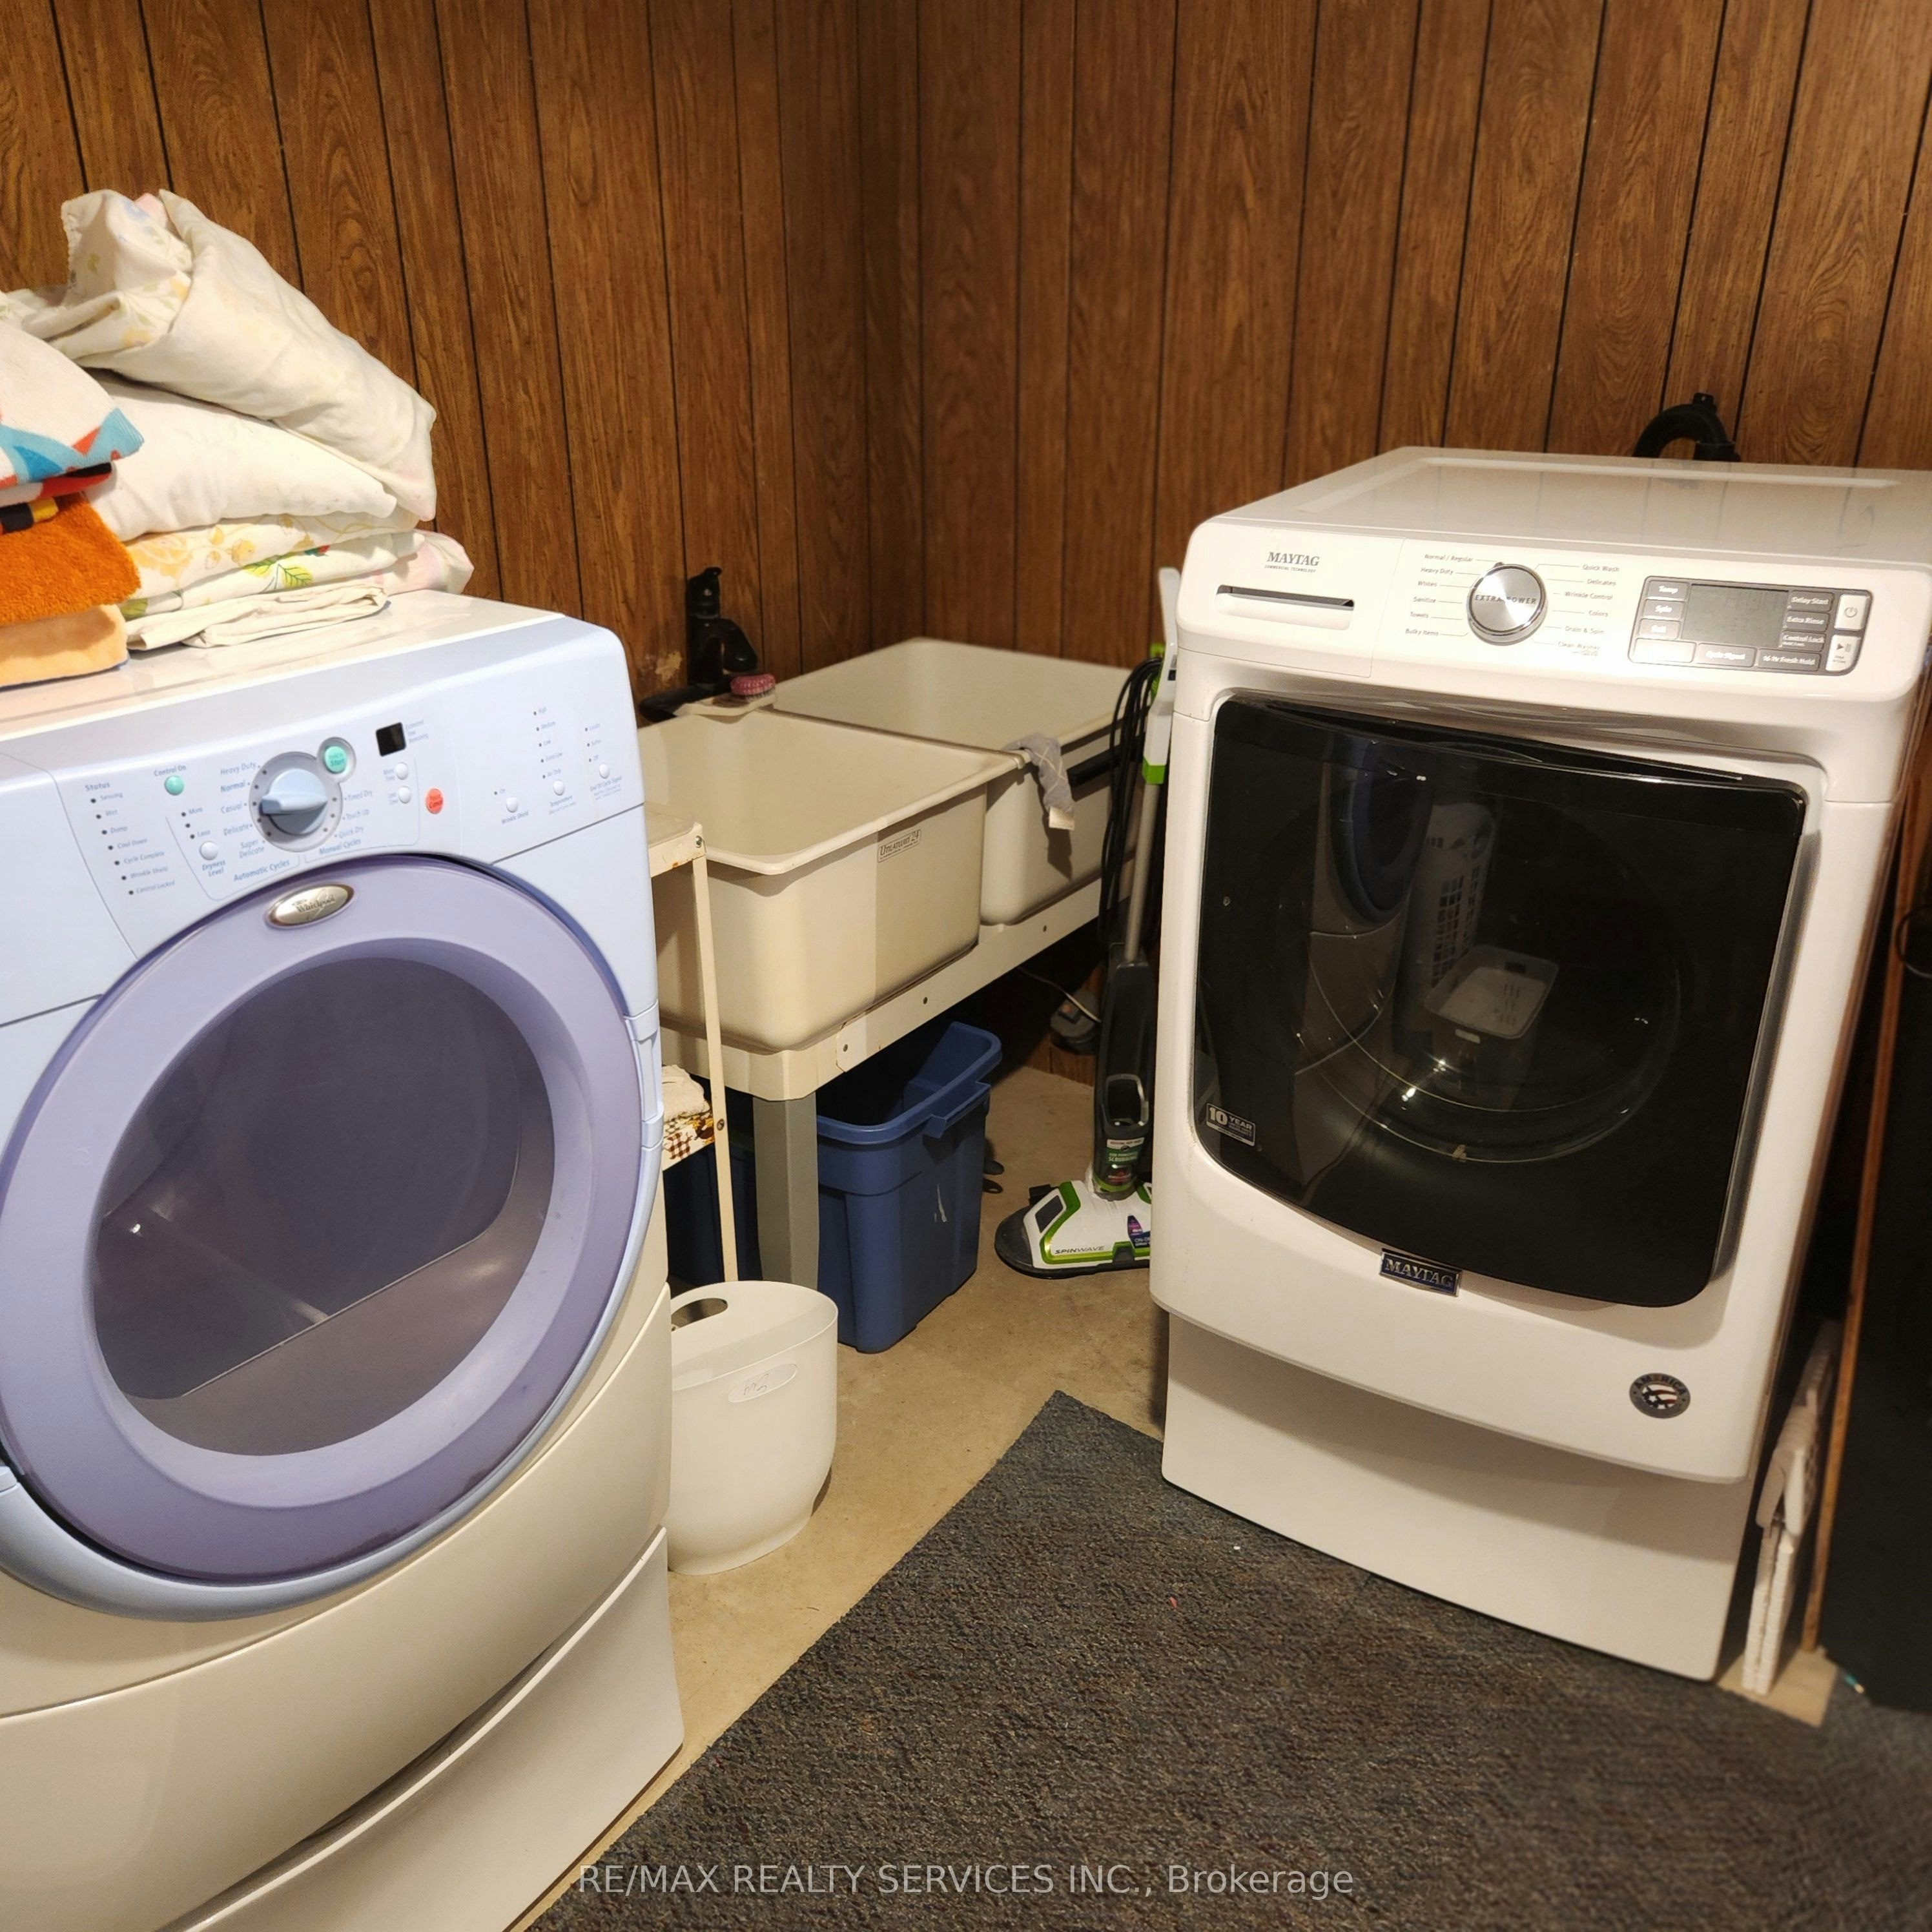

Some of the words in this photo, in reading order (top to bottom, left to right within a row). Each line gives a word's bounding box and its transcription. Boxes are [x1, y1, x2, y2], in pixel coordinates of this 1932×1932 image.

[1266, 551, 1320, 566] MAYTAG
[154, 765, 176, 776] Control
[220, 766, 240, 775] Heavy
[241, 762, 256, 772] Duty
[85, 782, 110, 792] Status
[220, 780, 245, 793] Normal
[100, 792, 123, 801] Sensing
[220, 802, 243, 814] Casual
[223, 823, 250, 836] Delicate
[117, 841, 130, 849] Cool
[131, 838, 148, 847] Down
[240, 839, 259, 850] Super
[319, 842, 342, 854] Manual
[343, 839, 362, 849] Cycles
[123, 856, 139, 865] Cycle
[139, 850, 165, 861] Complete
[239, 845, 265, 859] Delicate
[152, 865, 169, 875] Shield
[202, 859, 226, 872] Dryness
[233, 865, 268, 882] Automatic
[269, 859, 291, 872] Cycles
[207, 867, 225, 878] Level
[157, 879, 176, 890] Locked
[1209, 1107, 1228, 1125] 10
[1229, 1116, 1253, 1130] YEAR
[1054, 1246, 1105, 1254] SPINWAVE
[1384, 1259, 1453, 1288] MAYTAG
[1634, 1374, 1686, 1395] AMERICA
